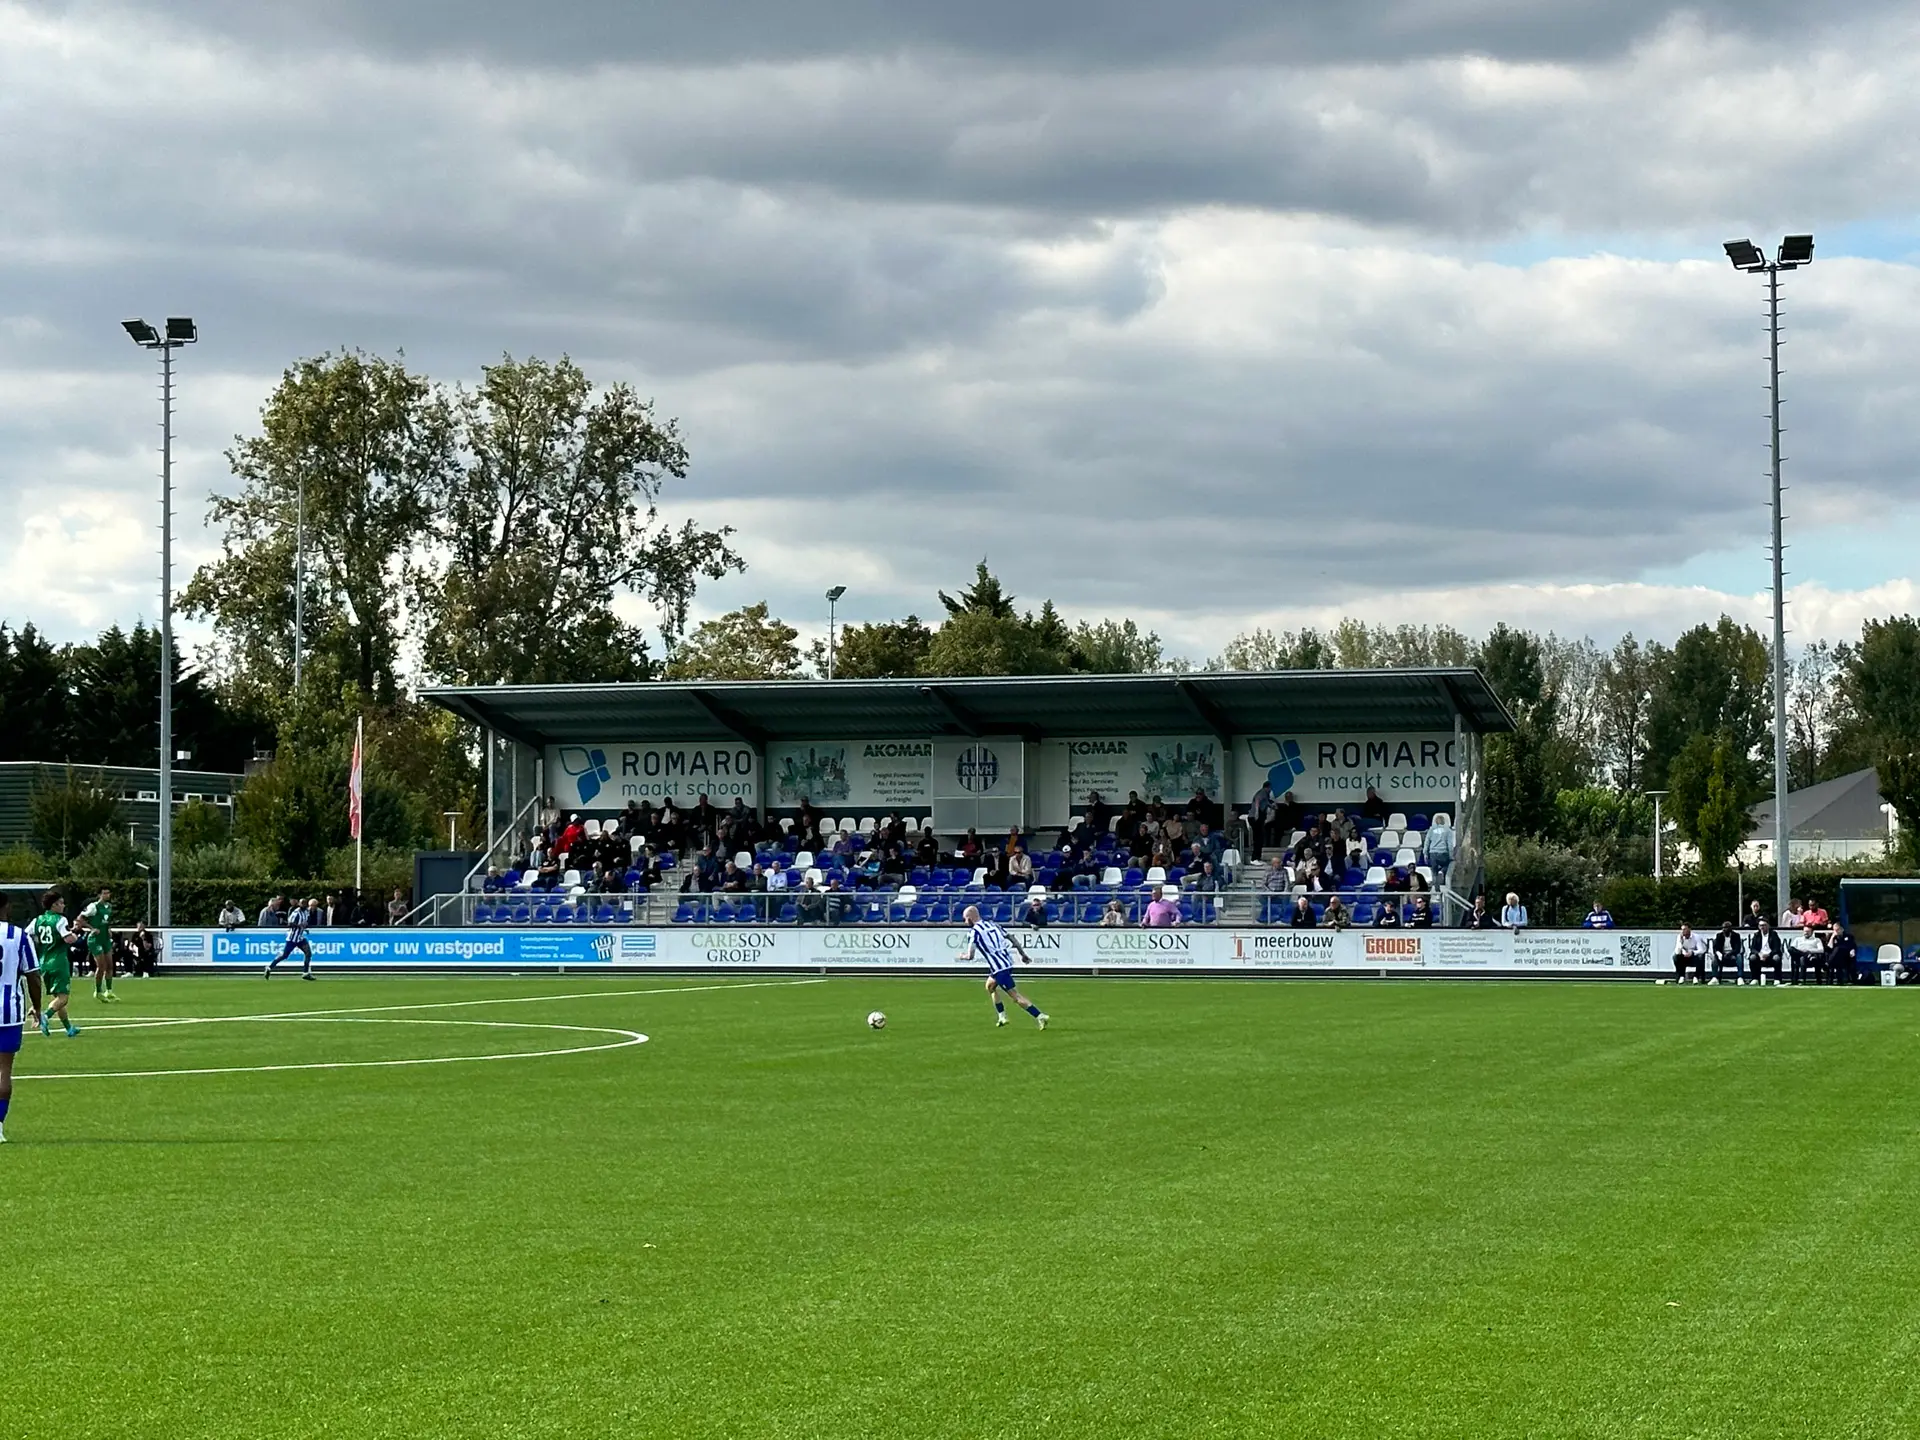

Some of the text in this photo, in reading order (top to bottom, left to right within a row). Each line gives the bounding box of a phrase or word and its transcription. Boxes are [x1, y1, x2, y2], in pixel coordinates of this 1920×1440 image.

[863, 743, 932, 757] AKOMAR
[1066, 741, 1128, 755] KOMAR
[1318, 740, 1456, 769] ROMARO
[621, 750, 752, 776] ROMARO
[622, 779, 752, 796] maakt schoon
[1318, 771, 1456, 790] maakt schoo
[38, 925, 53, 944] 23
[691, 932, 777, 948] CARESON
[823, 933, 911, 948] CARESON
[946, 933, 1061, 949] CAEAN
[1096, 934, 1190, 949] CARESON
[1254, 932, 1334, 948] meerbouw
[1570, 938, 1581, 946] wij
[217, 937, 504, 959] De instateur voor uw vastgoed
[1366, 937, 1422, 954] GROOS!
[1513, 947, 1530, 955] werk
[1553, 947, 1570, 955] Scan
[1571, 947, 1580, 955] de
[1580, 947, 1591, 956] QR
[1592, 947, 1610, 955] code
[707, 949, 761, 962] GROEP
[1254, 949, 1334, 959] ROTTERDAM BV
[1523, 957, 1538, 966] volg
[1553, 958, 1562, 966] op
